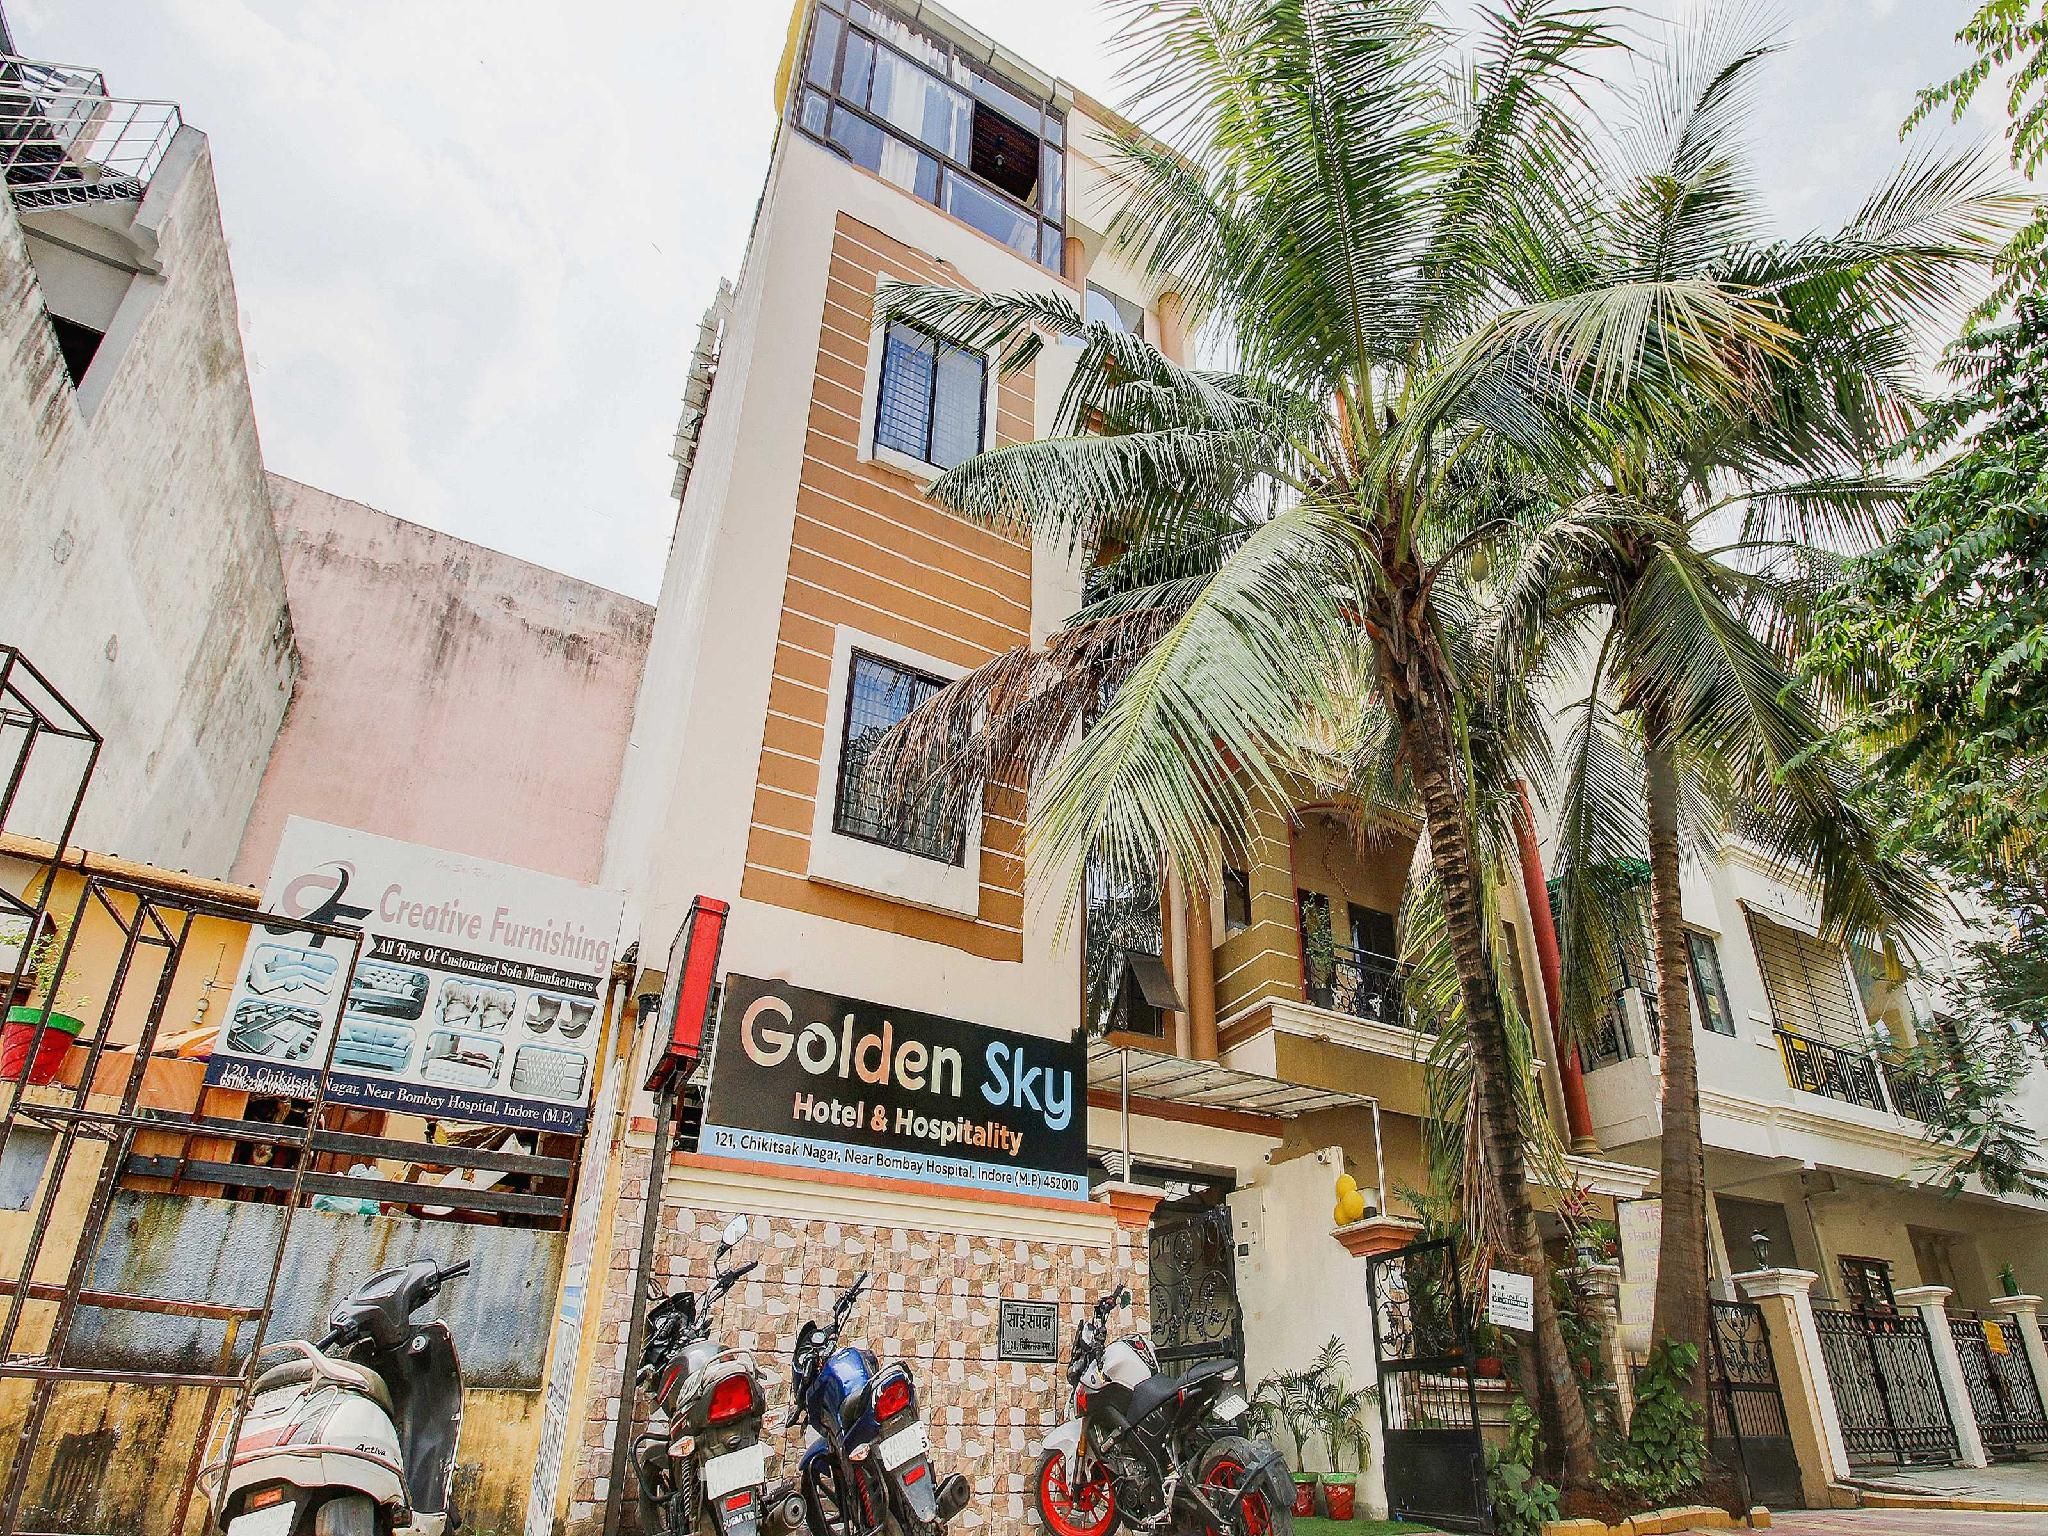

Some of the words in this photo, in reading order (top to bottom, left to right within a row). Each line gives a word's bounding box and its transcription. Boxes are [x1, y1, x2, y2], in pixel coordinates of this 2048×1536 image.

[380, 883, 482, 940] Creative
[489, 906, 610, 974] Furnishing
[377, 939, 393, 955] All
[396, 942, 421, 961] Type
[424, 947, 438, 962] Of
[440, 950, 499, 974] Customized
[499, 961, 523, 979] Sofa
[523, 965, 595, 992] Manufacturers
[256, 1066, 319, 1090] Chikitsak
[323, 1077, 360, 1098] Nagar,
[363, 1083, 395, 1099] Near
[397, 1087, 446, 1110] Bombay
[447, 1095, 500, 1117] Hospital,
[503, 1102, 540, 1119] Indore
[740, 995, 963, 1098] Golden
[980, 1040, 1073, 1131] Sky
[792, 1091, 865, 1129] Hotel
[870, 1104, 889, 1133] &
[894, 1106, 1024, 1158] Hospitality
[714, 1131, 737, 1150] 121,
[740, 1134, 800, 1158] Chikitsak
[802, 1142, 842, 1164] Nagar,
[844, 1149, 874, 1166] Near
[876, 1152, 924, 1175] Bombay
[926, 1159, 975, 1181] Hospital,
[978, 1166, 1012, 1184] Indore
[1014, 1171, 1041, 1188] (M.P)
[1043, 1178, 1079, 1193] 452010
[355, 1443, 386, 1456] Activa
